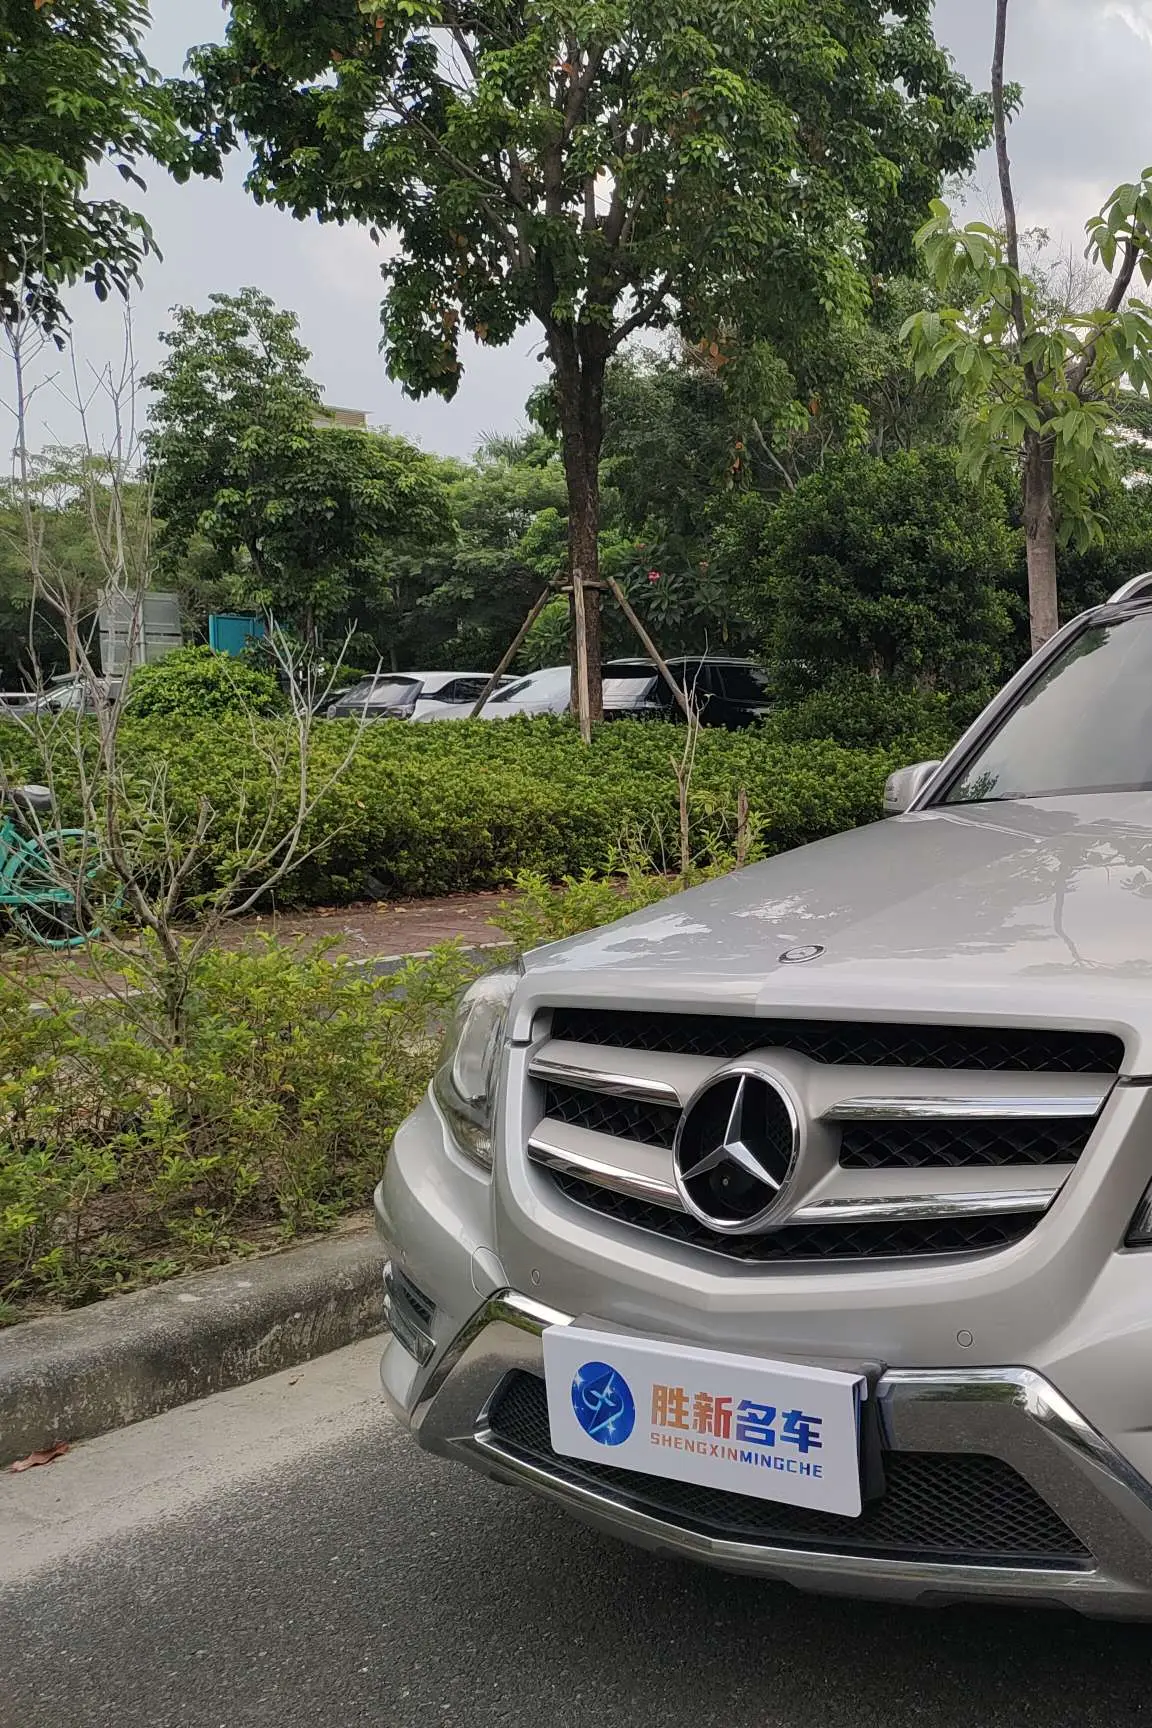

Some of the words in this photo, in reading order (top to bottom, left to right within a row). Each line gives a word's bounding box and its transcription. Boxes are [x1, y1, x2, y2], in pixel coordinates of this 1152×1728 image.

[651, 1383, 823, 1454] 胜新名车
[650, 1432, 823, 1479] SHENGXINMINGCHE
